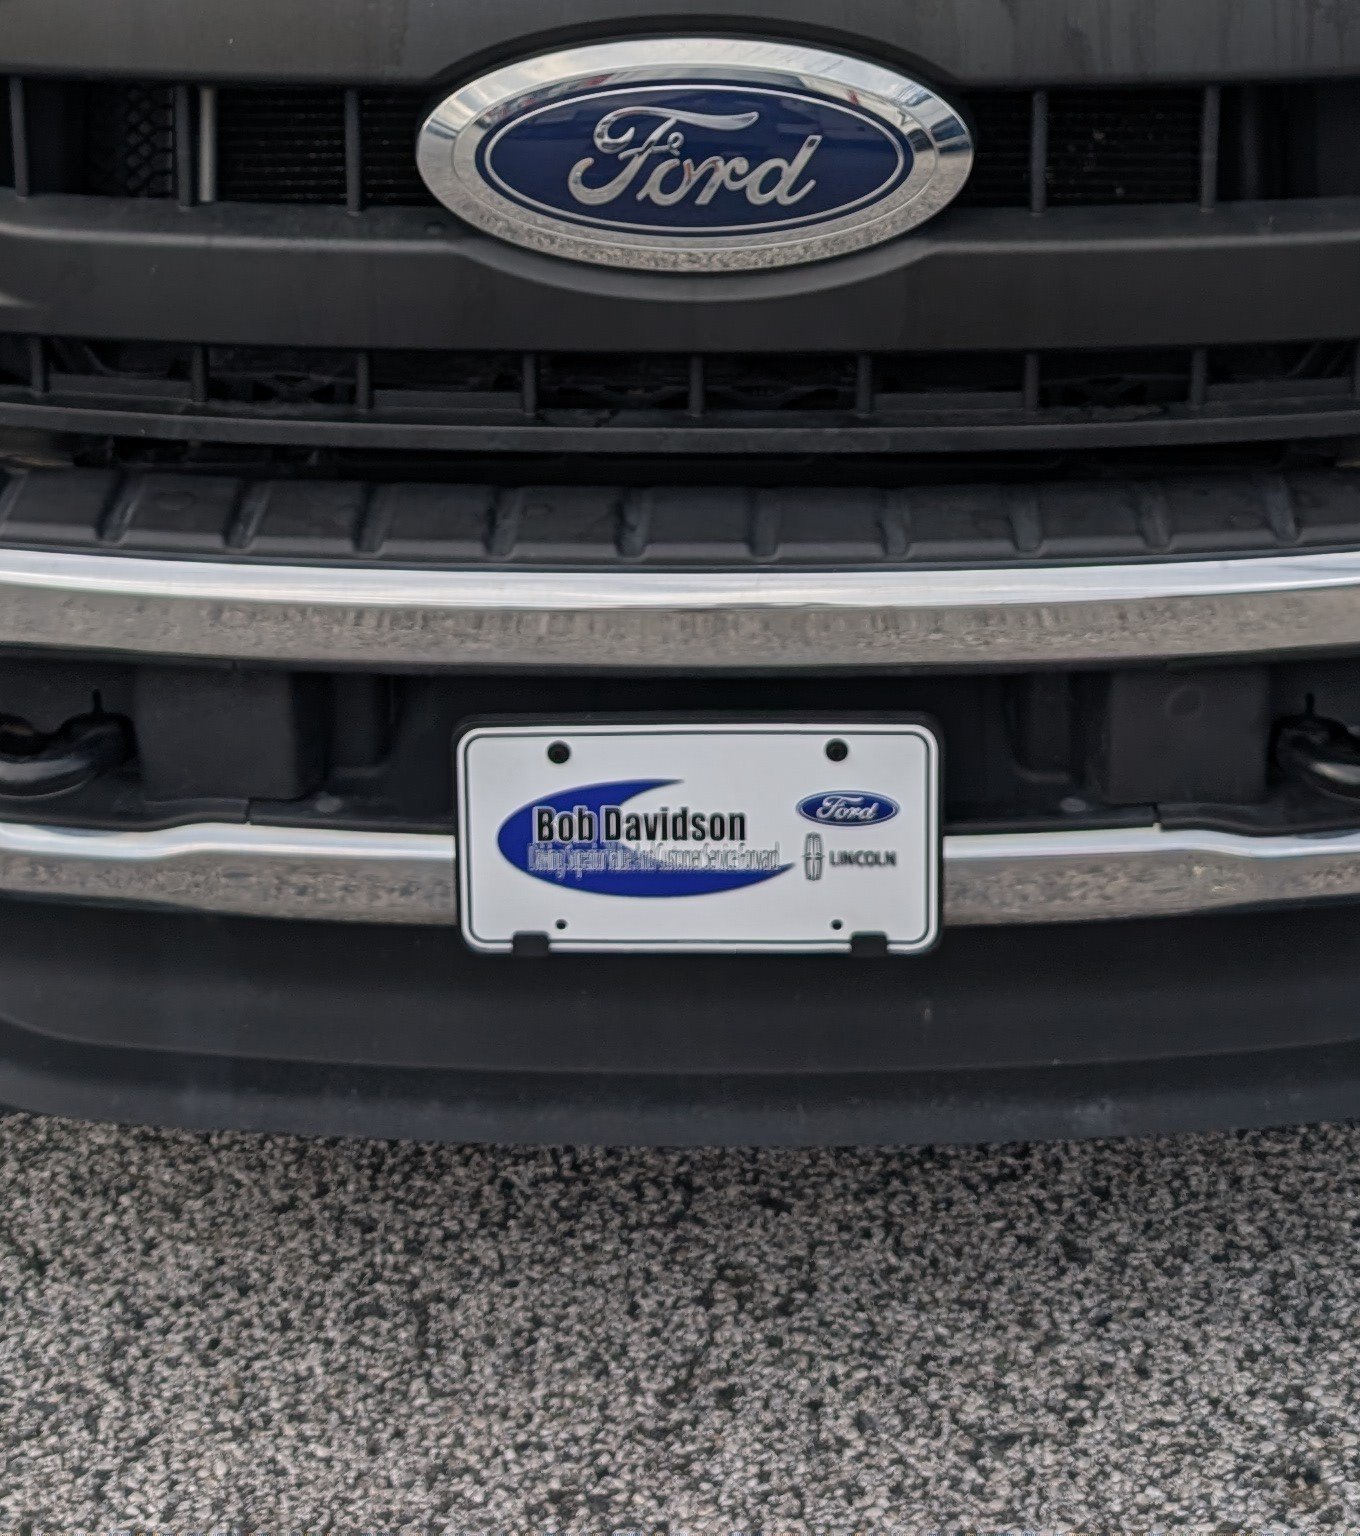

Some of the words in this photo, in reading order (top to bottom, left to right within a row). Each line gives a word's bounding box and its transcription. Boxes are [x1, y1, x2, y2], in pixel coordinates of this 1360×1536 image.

[567, 105, 822, 207] Ford
[815, 795, 880, 821] Ford
[536, 806, 596, 843] Bob
[603, 806, 747, 843] Davidson
[828, 850, 897, 867] LINCOLN
